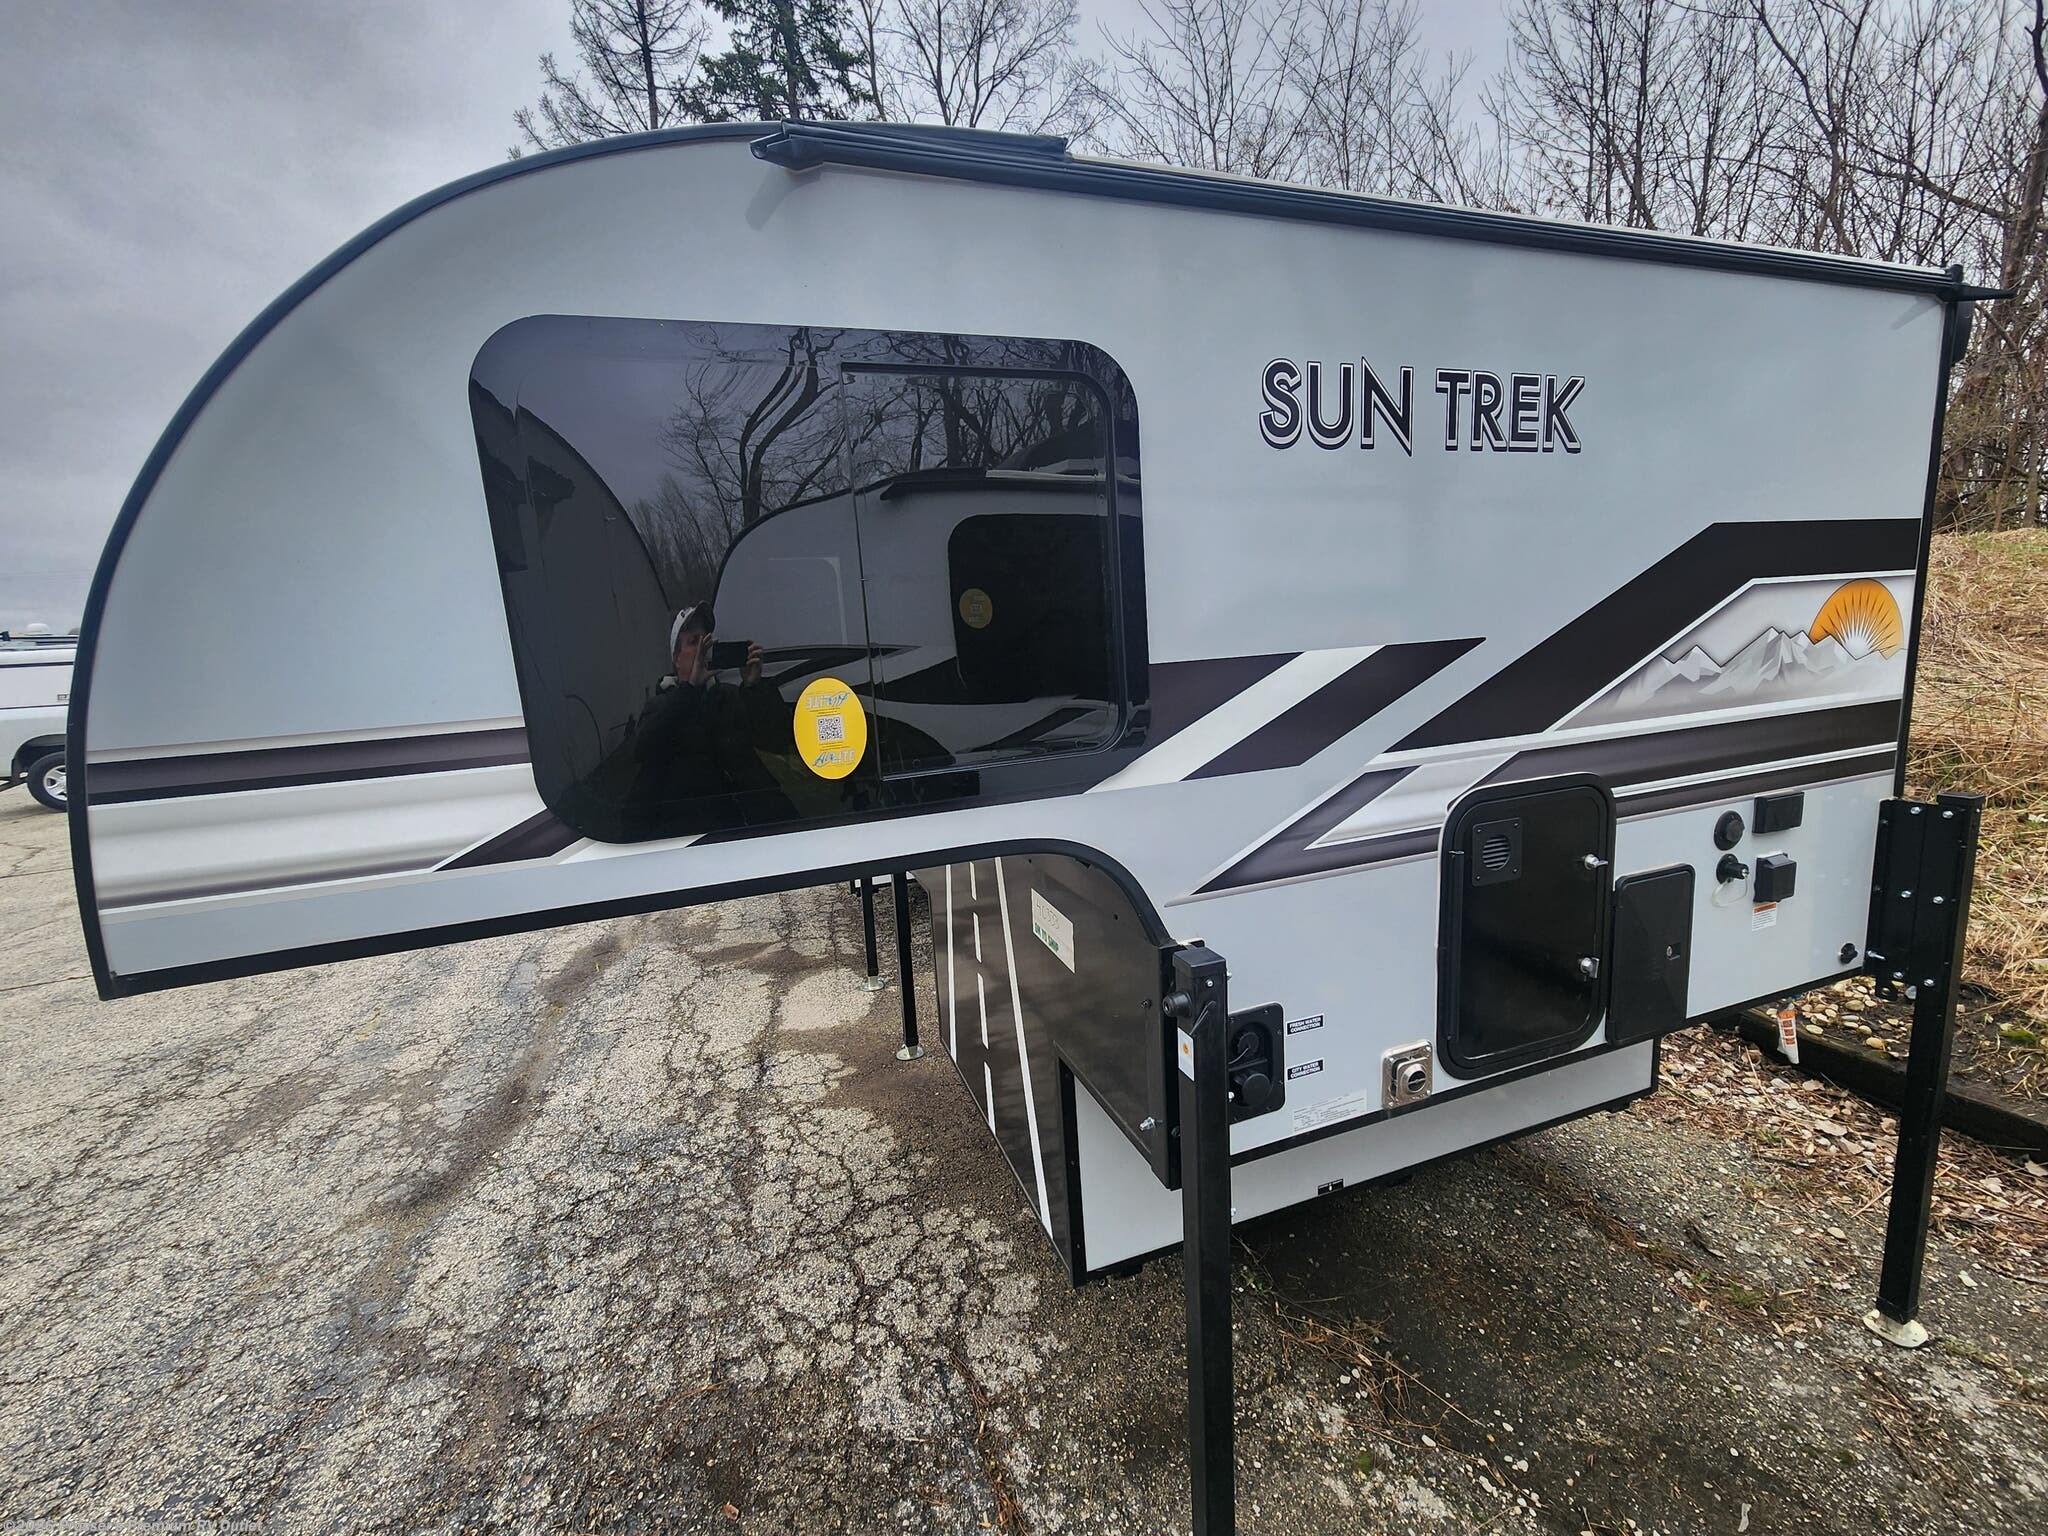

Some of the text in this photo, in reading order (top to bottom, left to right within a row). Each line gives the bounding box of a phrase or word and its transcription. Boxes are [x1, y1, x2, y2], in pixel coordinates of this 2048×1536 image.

[1259, 355, 1586, 457] SUN TREK
[1289, 1016, 1321, 1029] FRESH WATER
[1290, 1022, 1321, 1033] CONNECTION
[1290, 1066, 1321, 1079] CONNECTION
[1291, 1061, 1319, 1074] CITY WATER
